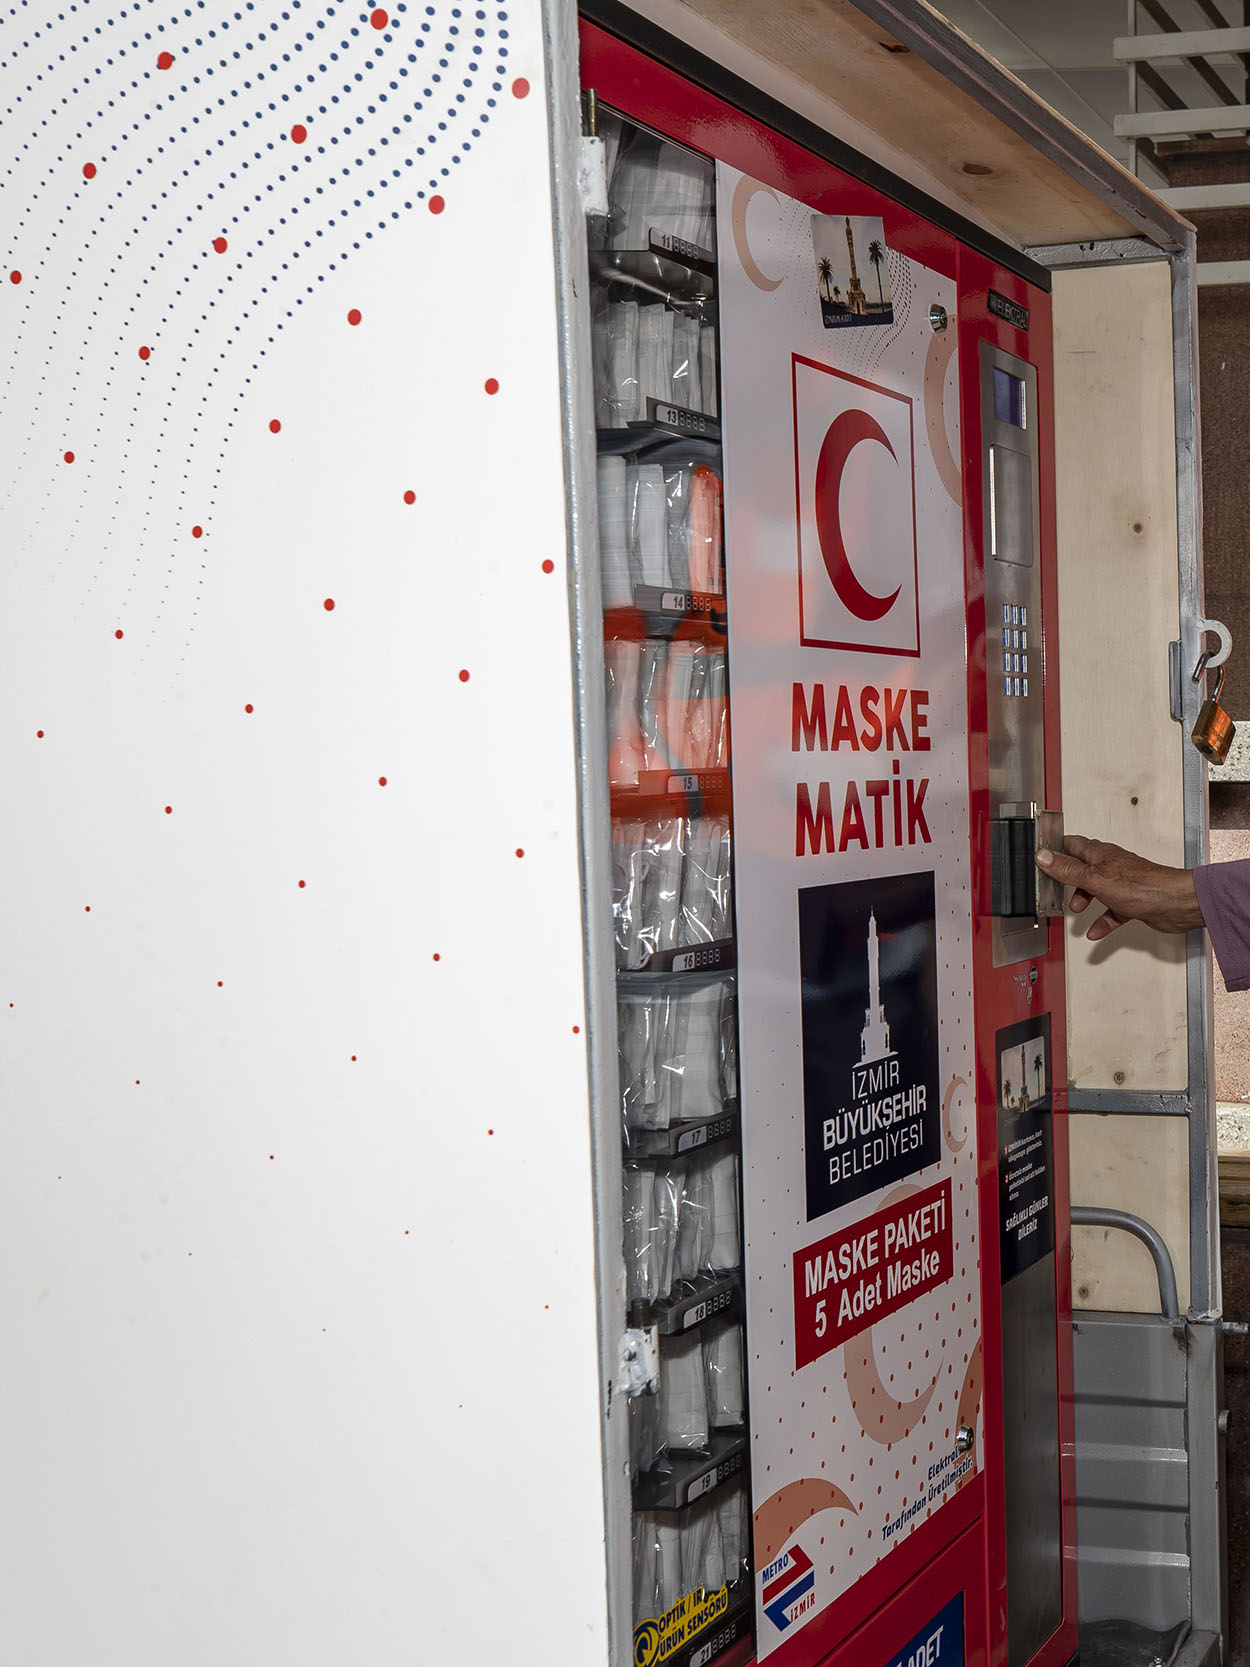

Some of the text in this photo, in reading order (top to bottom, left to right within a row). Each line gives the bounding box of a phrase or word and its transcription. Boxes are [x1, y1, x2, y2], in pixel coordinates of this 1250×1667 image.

[662, 234, 670, 249] 11
[667, 409, 677, 424] 13
[673, 595, 683, 609] 14
[791, 682, 931, 752] MASKE
[683, 776, 693, 790] 15
[795, 759, 932, 857] MATİK
[684, 954, 693, 968] 16
[852, 1060, 900, 1100] İZMİR
[823, 1084, 927, 1151] BÜYÜKŞEHİR
[691, 1129, 702, 1145] 17
[829, 1118, 924, 1185] BELEDİYESİ
[1029, 1195, 1049, 1217] GÜNLER
[804, 1190, 946, 1298] MASKE PAKETİ
[1018, 1217, 1038, 1240] DİLERİZ
[815, 1248, 940, 1338] 5 Adet Maske
[695, 1305, 705, 1321] 18
[702, 1474, 711, 1490] 19
[882, 1496, 927, 1541] Tarafından
[762, 1553, 789, 1585] METRO
[658, 1600, 686, 1634] OPTİK
[660, 1588, 728, 1657] ÜRÜN SENSÖRÜ
[790, 1592, 816, 1623] İZMİR
[700, 1644, 711, 1664] 21
